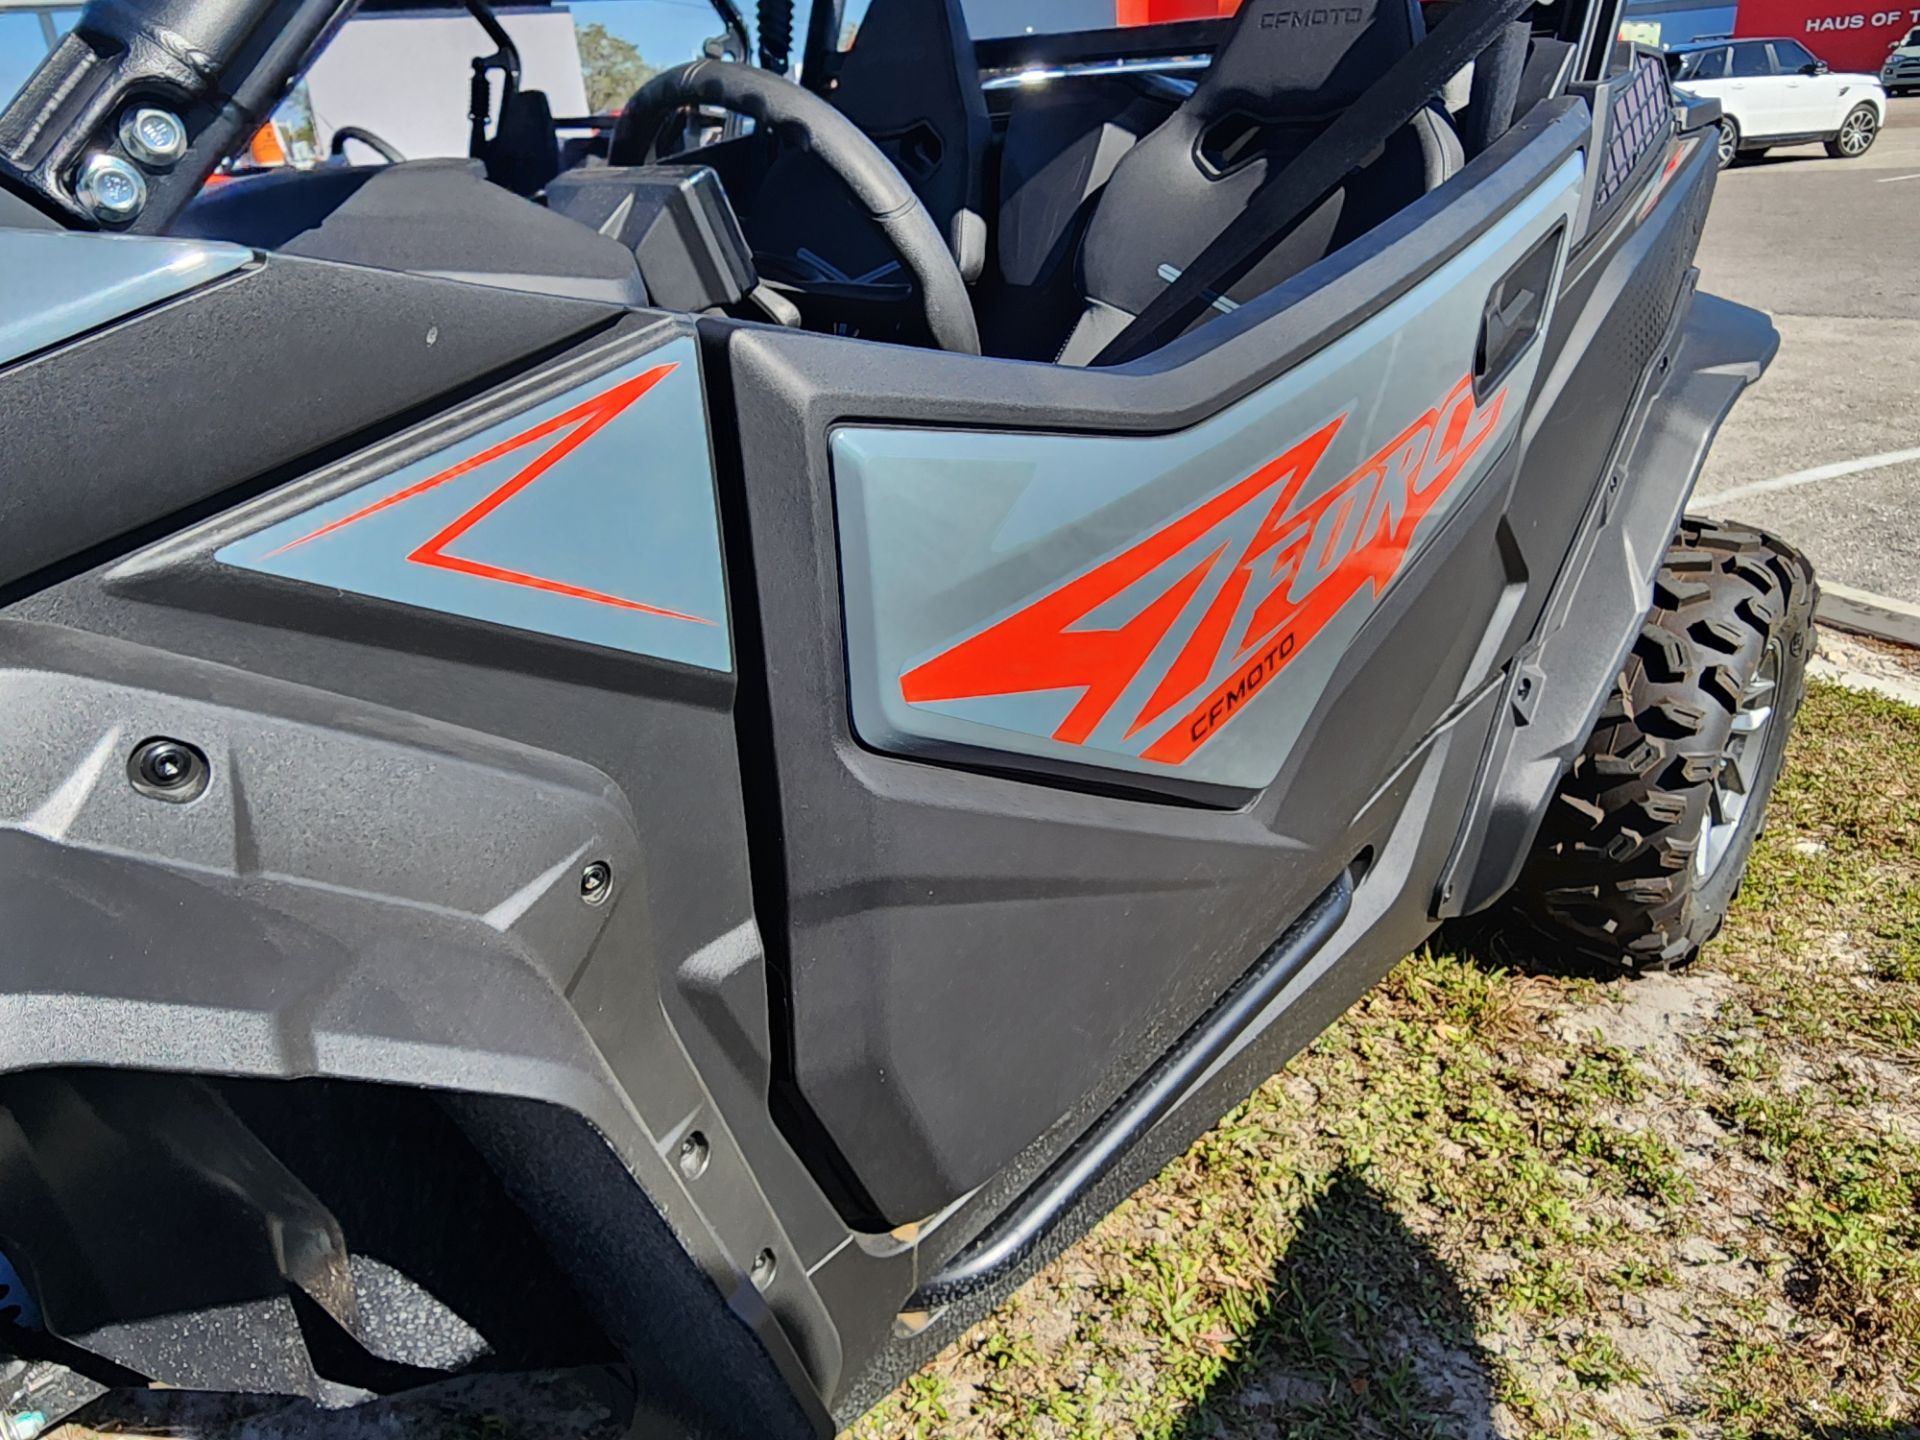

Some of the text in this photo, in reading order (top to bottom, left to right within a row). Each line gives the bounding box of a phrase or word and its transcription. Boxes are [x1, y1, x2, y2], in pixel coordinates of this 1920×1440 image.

[1260, 7, 1362, 28] CFMOTO
[1805, 14, 1865, 32] HAUS
[1871, 11, 1901, 27] OF
[1191, 632, 1294, 742] CFMOTO
